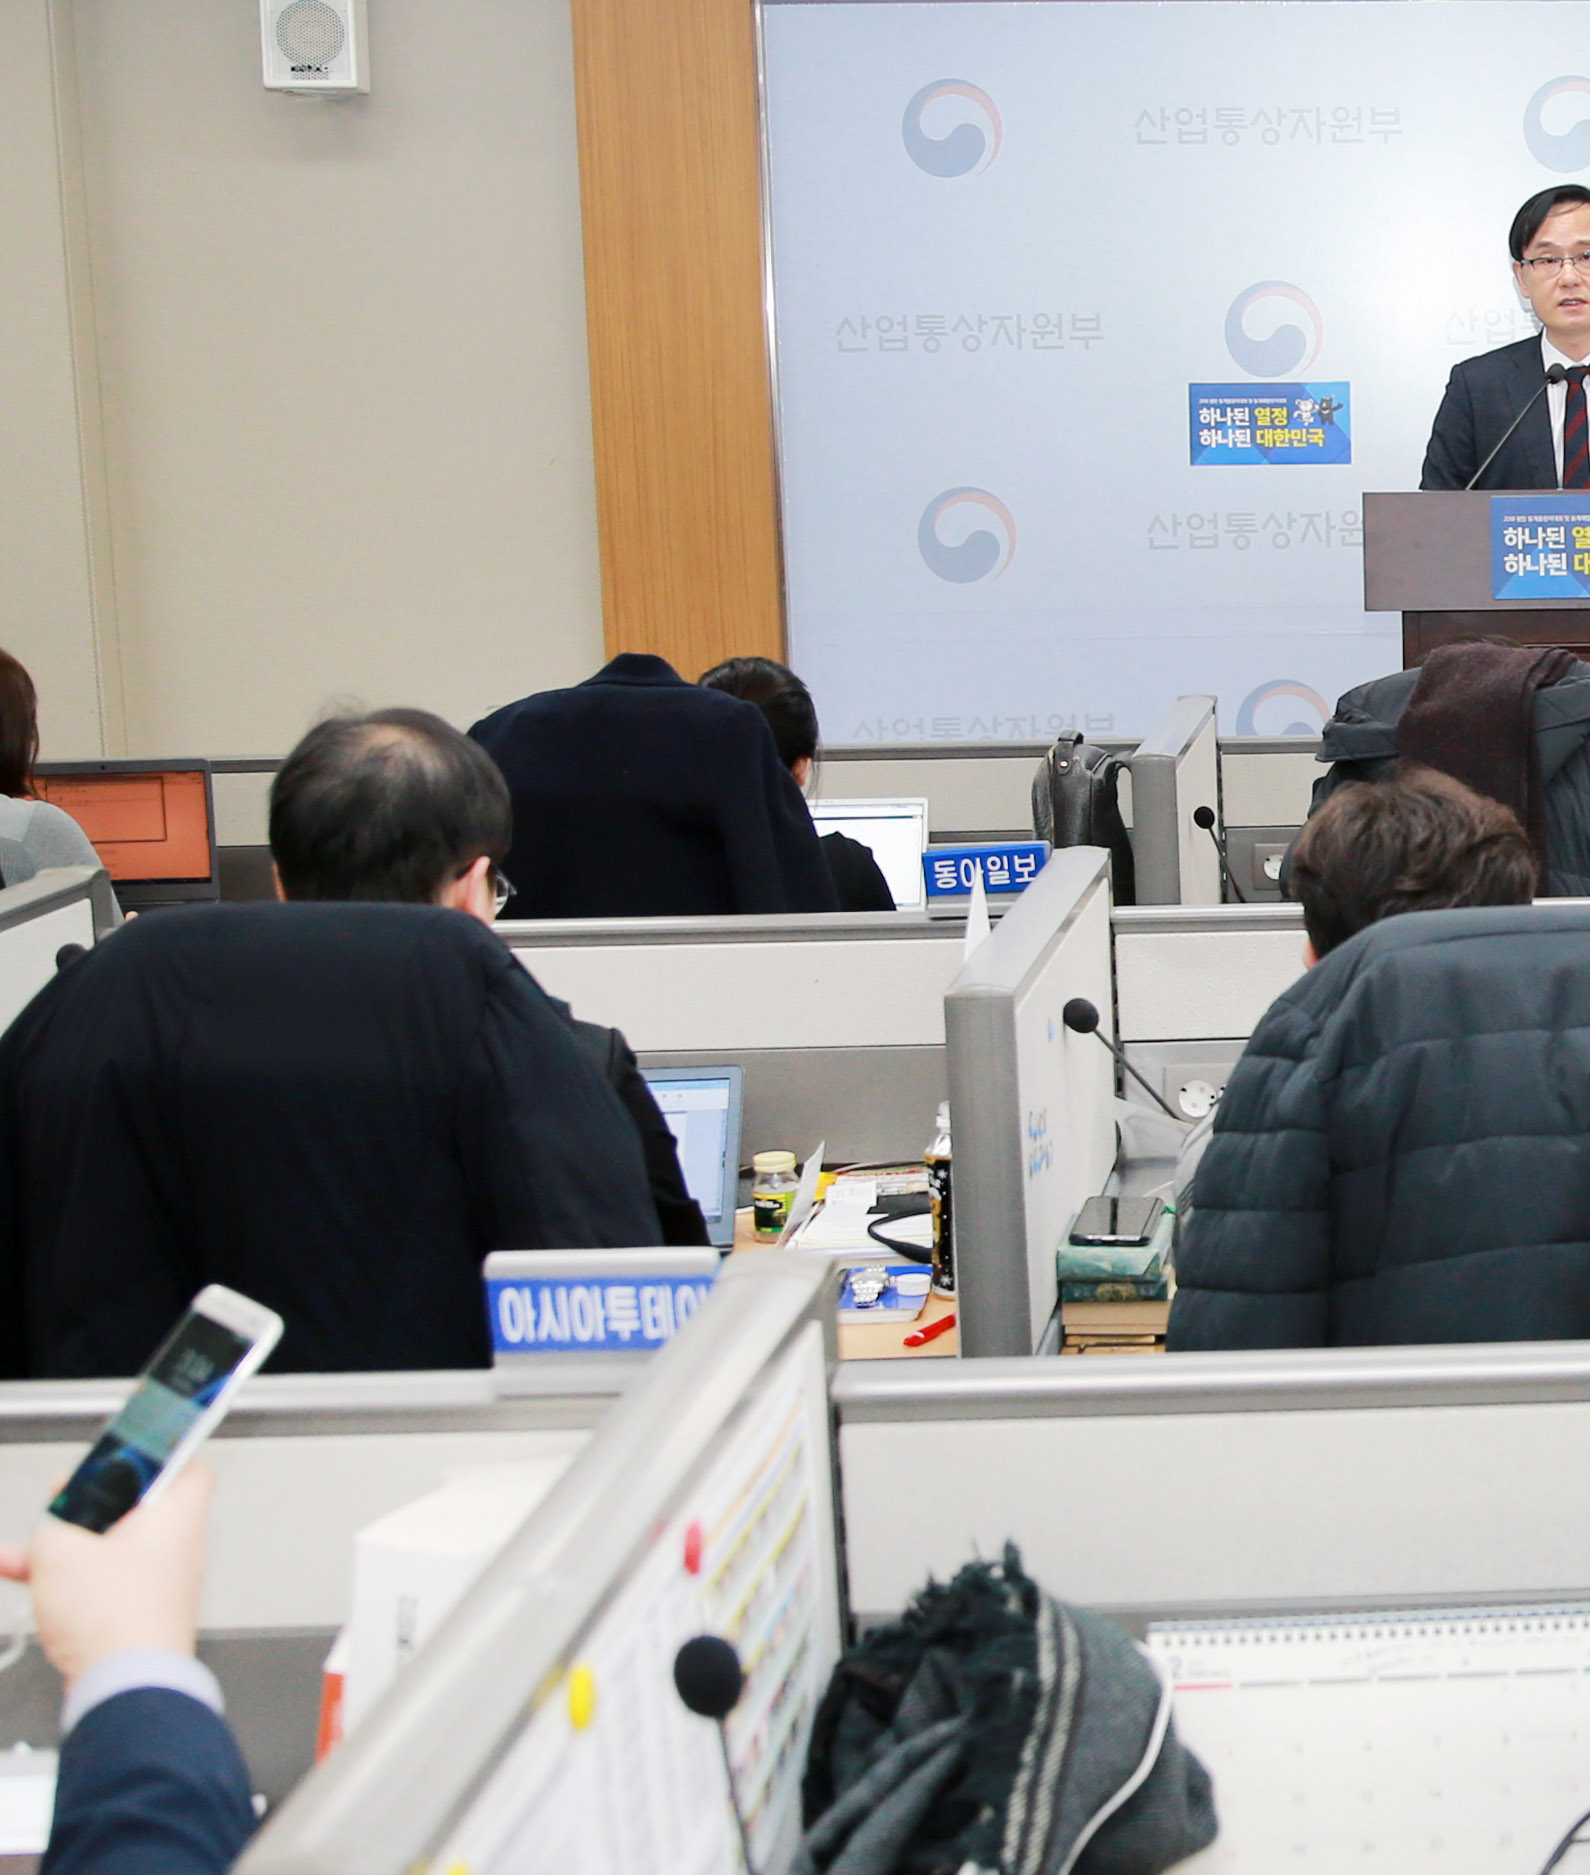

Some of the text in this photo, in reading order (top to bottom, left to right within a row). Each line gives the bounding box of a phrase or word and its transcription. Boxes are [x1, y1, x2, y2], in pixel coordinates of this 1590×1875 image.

[1134, 106, 1402, 146] 산업통상자원부
[836, 312, 1104, 353] 산업통상자원부
[1199, 406, 1289, 426] 하나된 열정
[1199, 427, 1325, 448] 하나된 대한민국
[1147, 510, 1363, 551] 산업통상자원
[1503, 526, 1566, 549] 하나된
[1503, 552, 1568, 576] 하나된
[934, 854, 1037, 889] 동아일보
